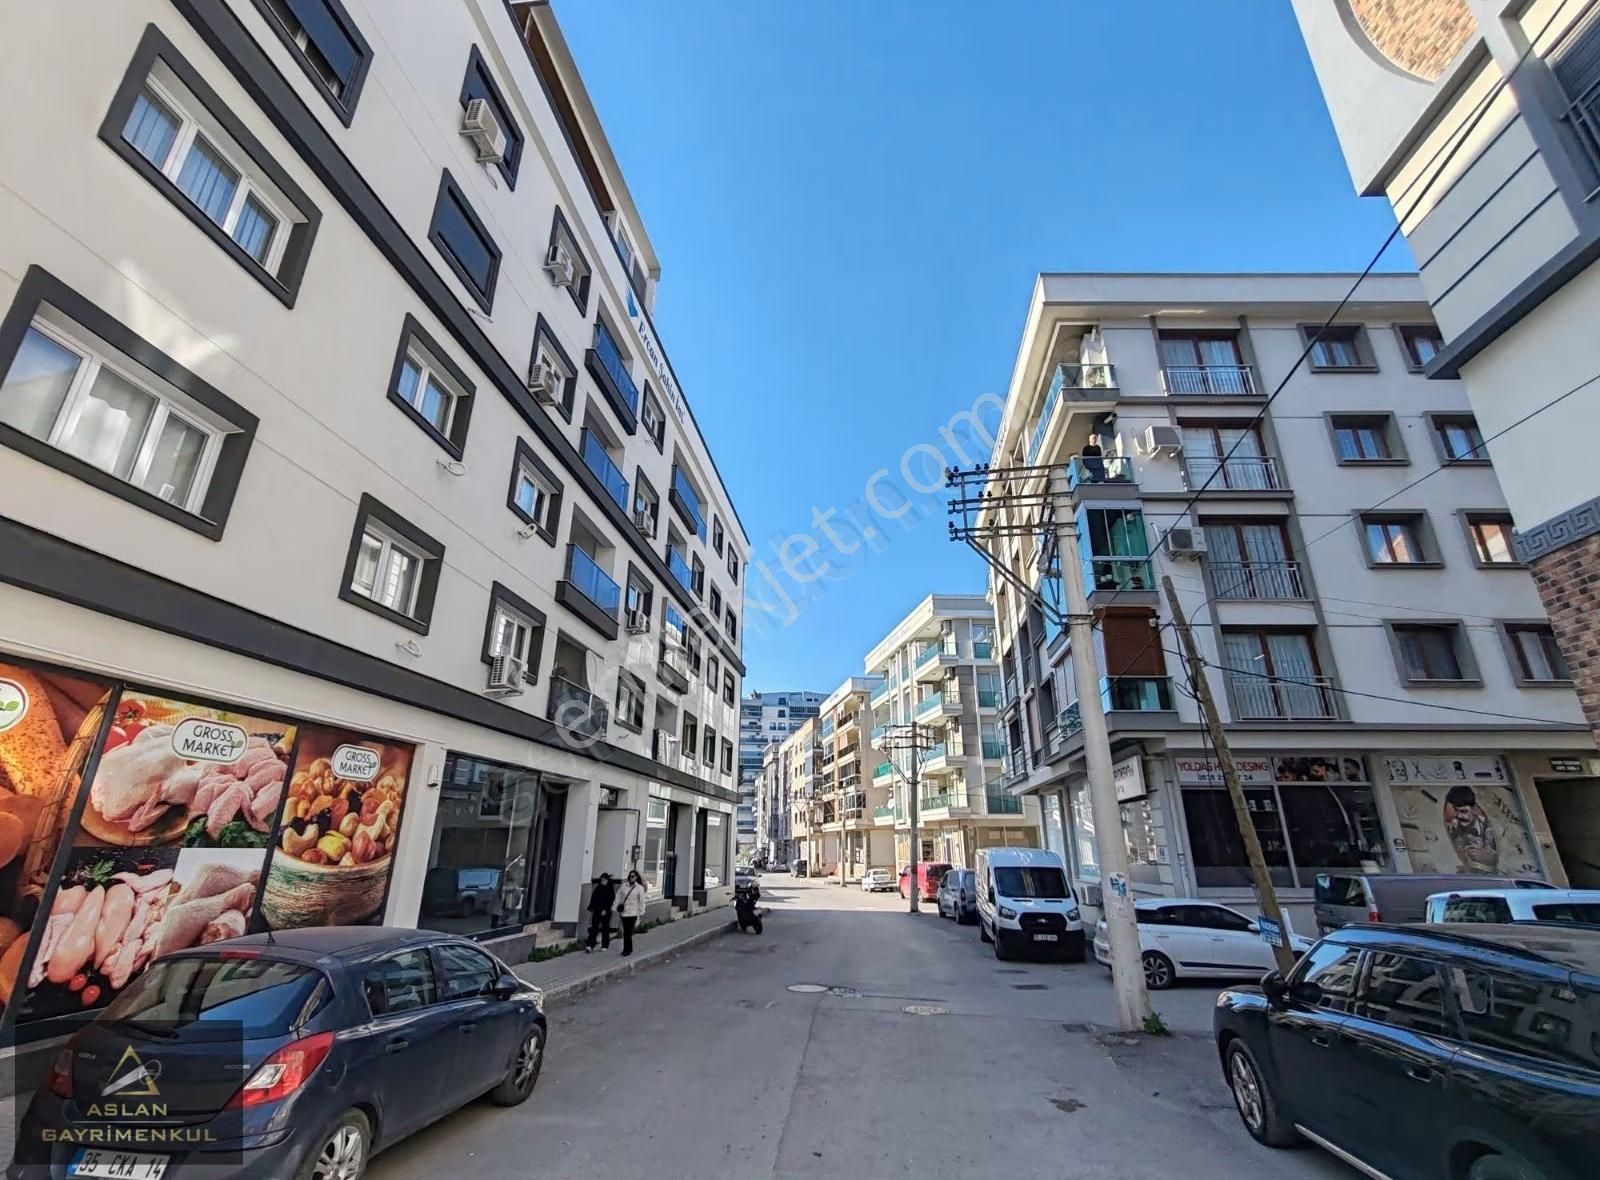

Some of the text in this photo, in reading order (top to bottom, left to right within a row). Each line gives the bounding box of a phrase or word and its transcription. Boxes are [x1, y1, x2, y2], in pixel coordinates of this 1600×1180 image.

[193, 724, 234, 743] GROSS
[182, 738, 236, 758] MARKET
[345, 750, 371, 764] GROSS
[339, 762, 374, 776] MARKET
[79, 1151, 164, 1179] 35 CKA 14
